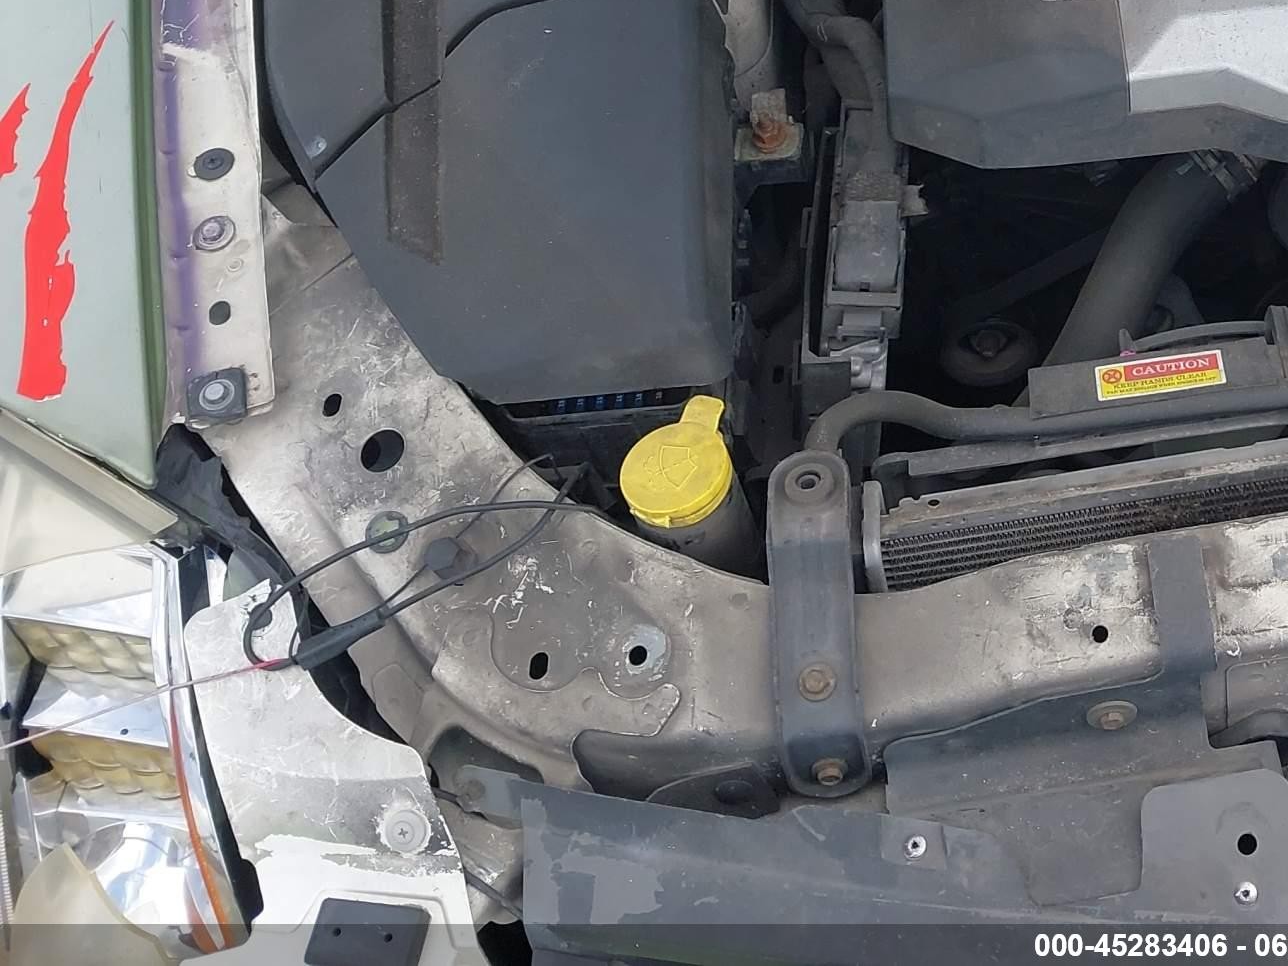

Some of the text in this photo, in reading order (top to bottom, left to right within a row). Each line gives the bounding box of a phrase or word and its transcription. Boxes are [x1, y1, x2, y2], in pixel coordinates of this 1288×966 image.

[1132, 357, 1210, 376] CAUTION
[1113, 371, 1208, 389] KEEP HANDS CLEAR
